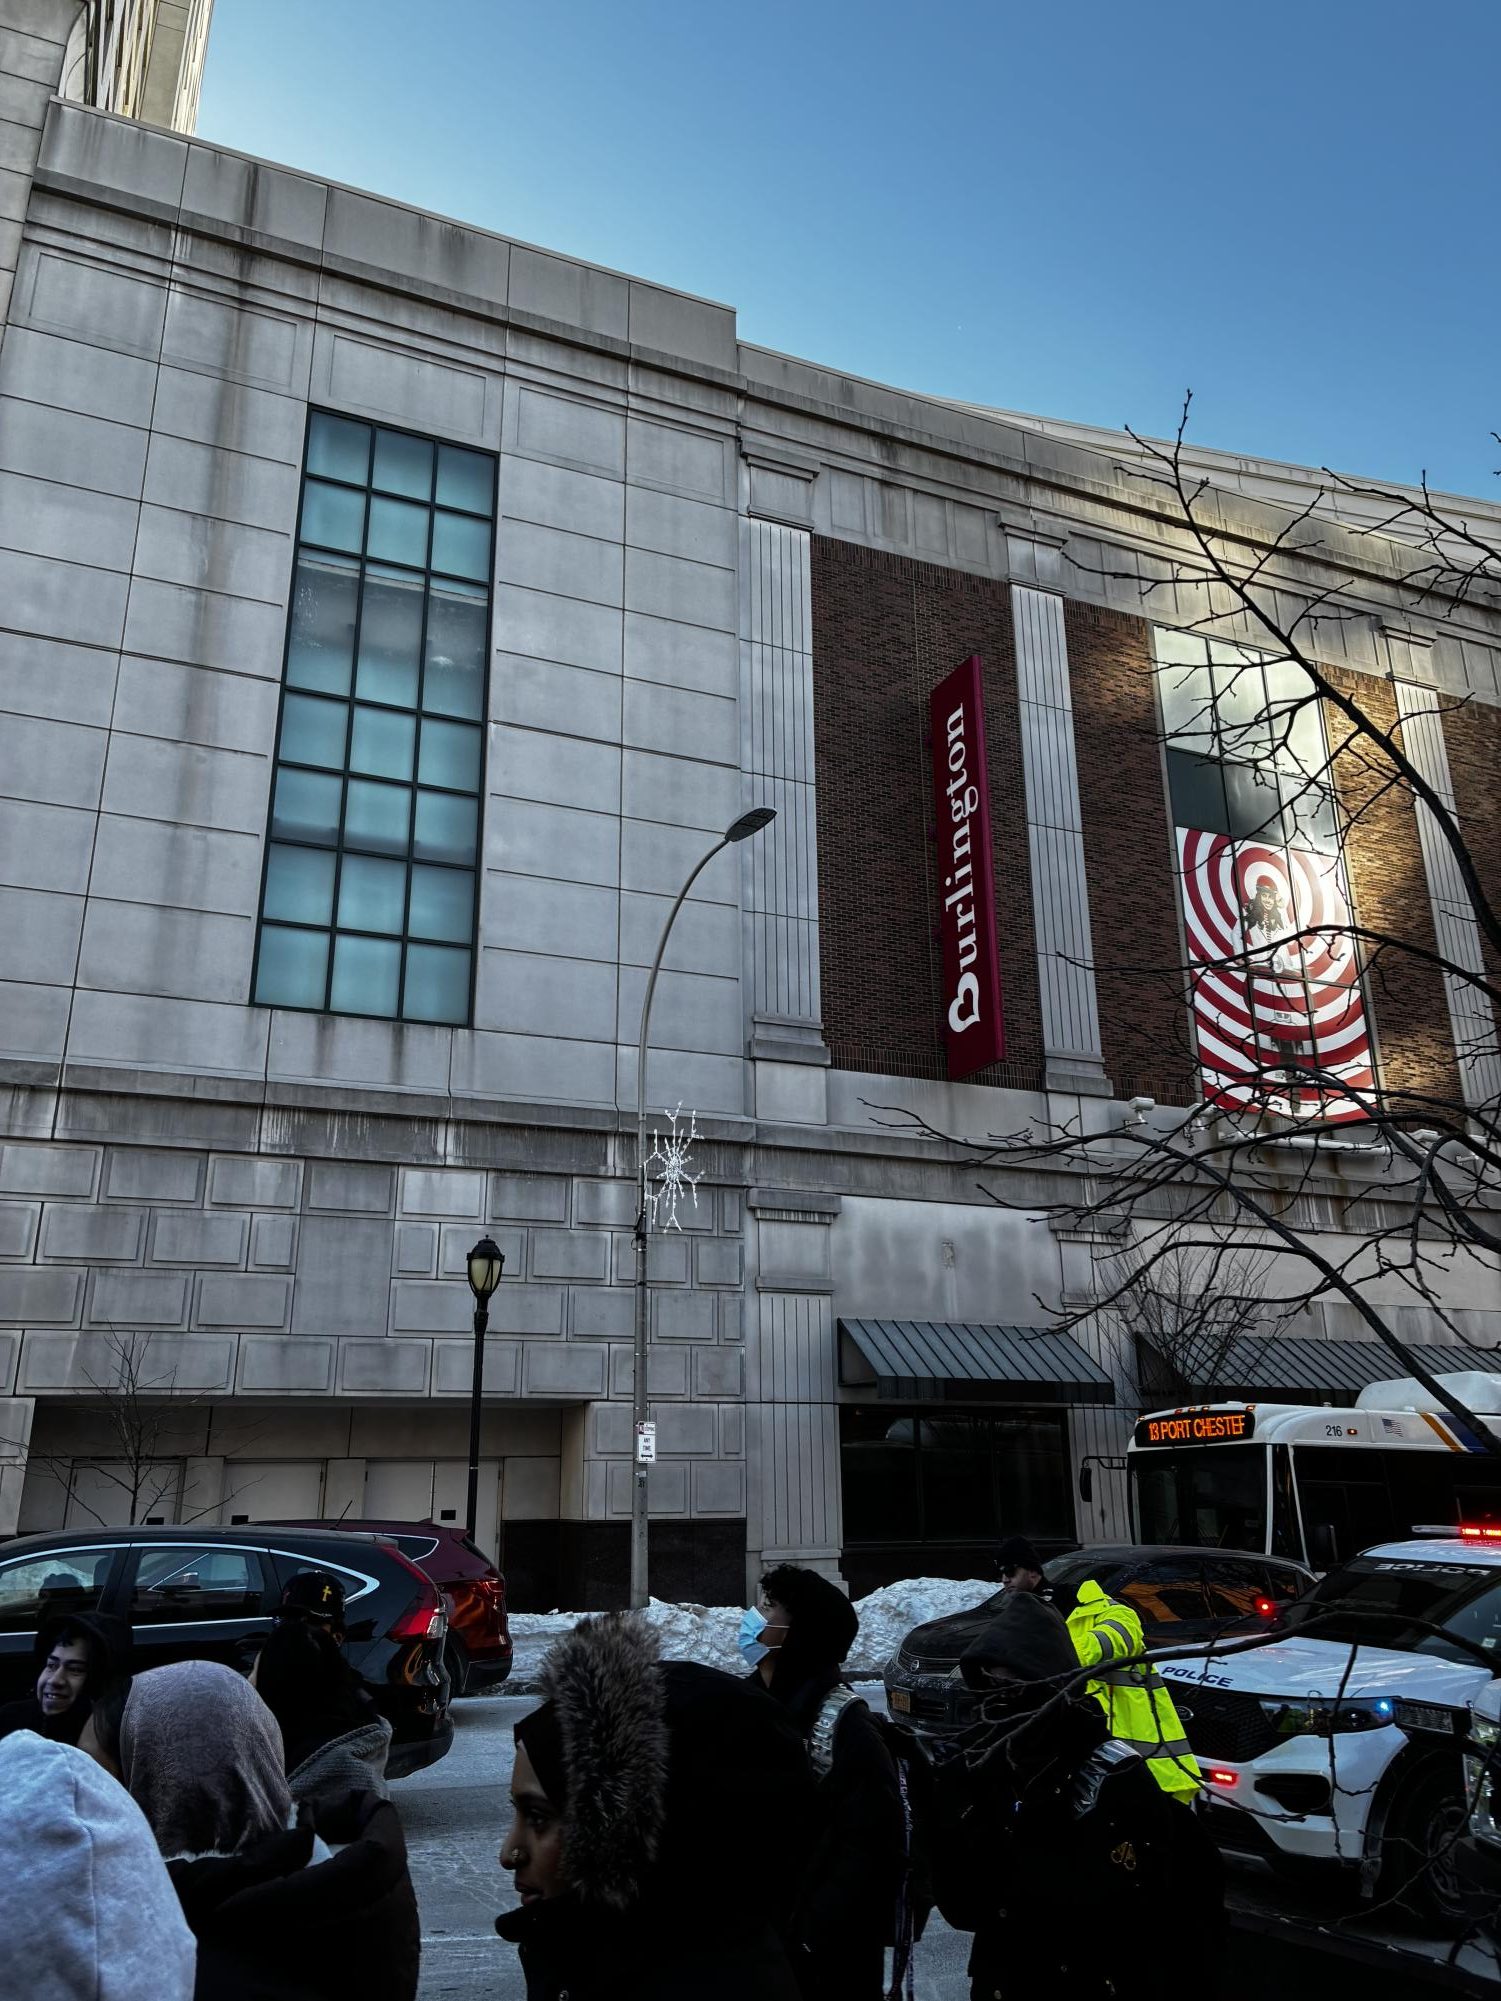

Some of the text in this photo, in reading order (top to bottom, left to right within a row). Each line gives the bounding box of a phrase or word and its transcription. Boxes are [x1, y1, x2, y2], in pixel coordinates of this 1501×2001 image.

[945, 702, 981, 1033] Burlington
[1149, 1422, 1160, 1440] 13
[1161, 1419, 1191, 1440] PORT
[1325, 1425, 1343, 1437] 216
[1161, 1666, 1234, 1687] POLICE
